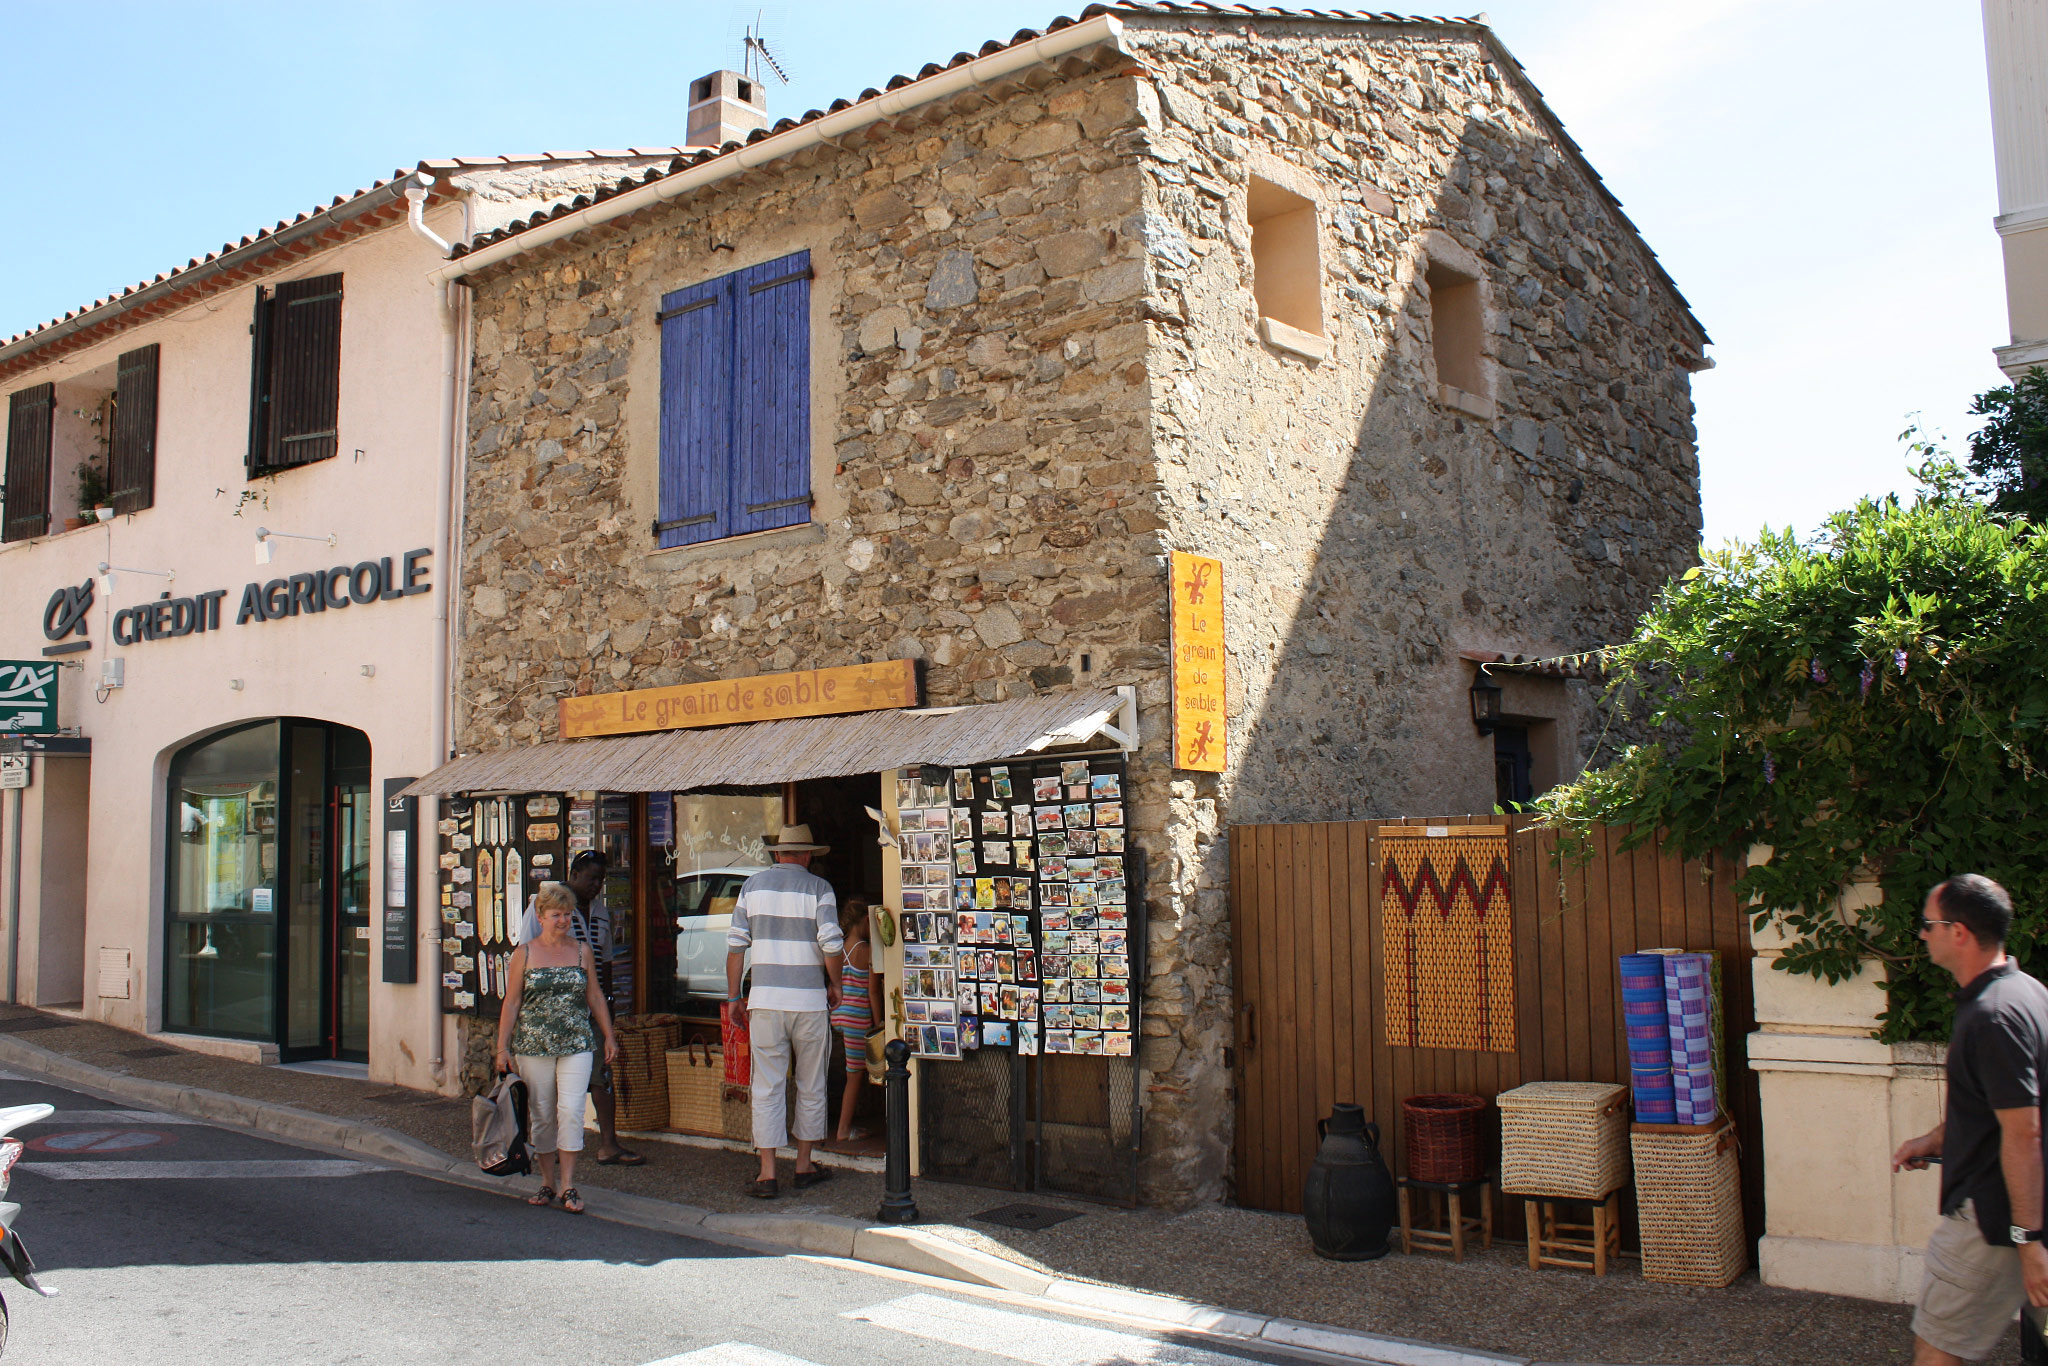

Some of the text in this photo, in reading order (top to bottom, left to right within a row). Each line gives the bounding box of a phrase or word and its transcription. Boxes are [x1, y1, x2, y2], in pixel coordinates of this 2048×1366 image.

[113, 547, 432, 647] CRÉDIT AGRICOLE
[1192, 613, 1207, 632] Le
[1183, 643, 1216, 662] grain
[1193, 668, 1208, 685] de
[622, 671, 836, 728] Le grain de sable
[1185, 693, 1217, 713] sable
[664, 838, 680, 867] Le
[720, 825, 731, 846] de
